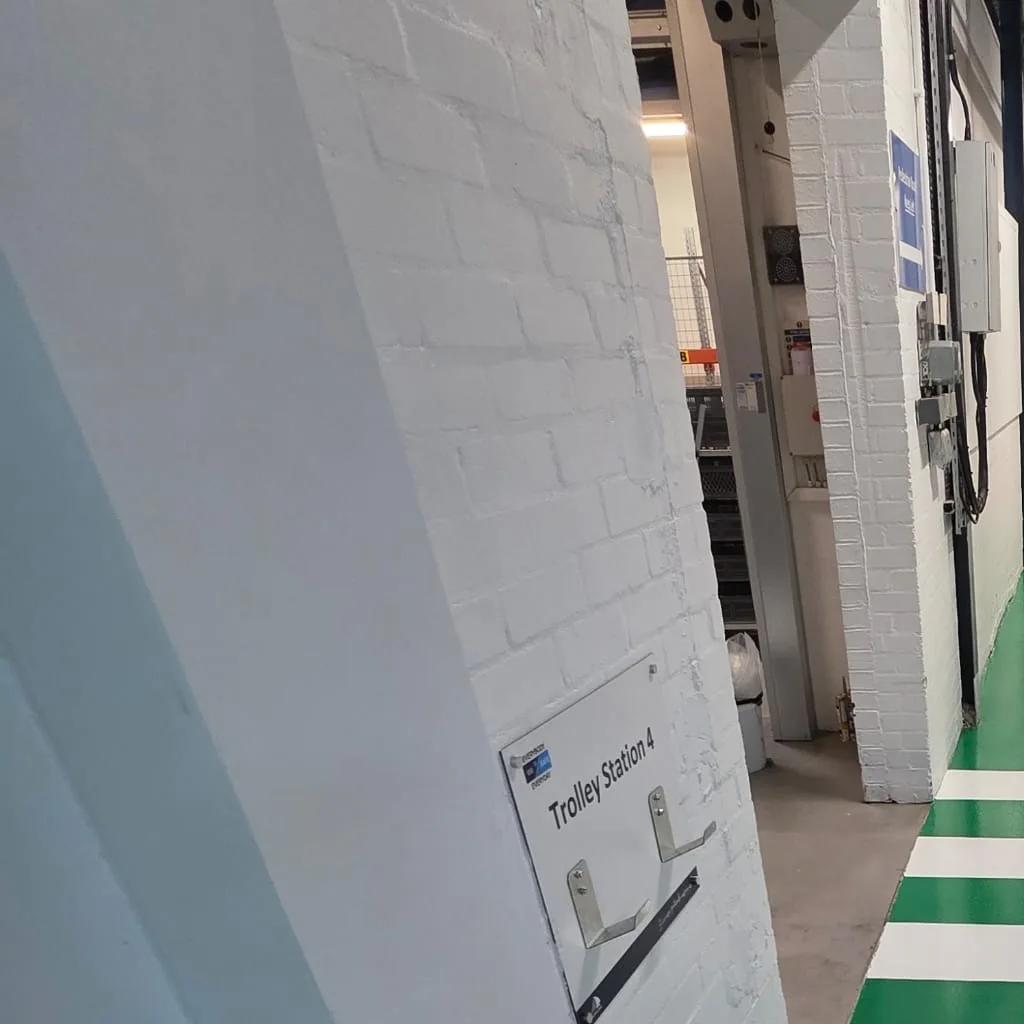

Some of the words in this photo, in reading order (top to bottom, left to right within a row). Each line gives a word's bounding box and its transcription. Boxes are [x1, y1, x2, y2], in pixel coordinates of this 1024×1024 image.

[548, 775, 601, 830] Trolley
[601, 739, 646, 789] Station
[646, 726, 654, 750] 4
